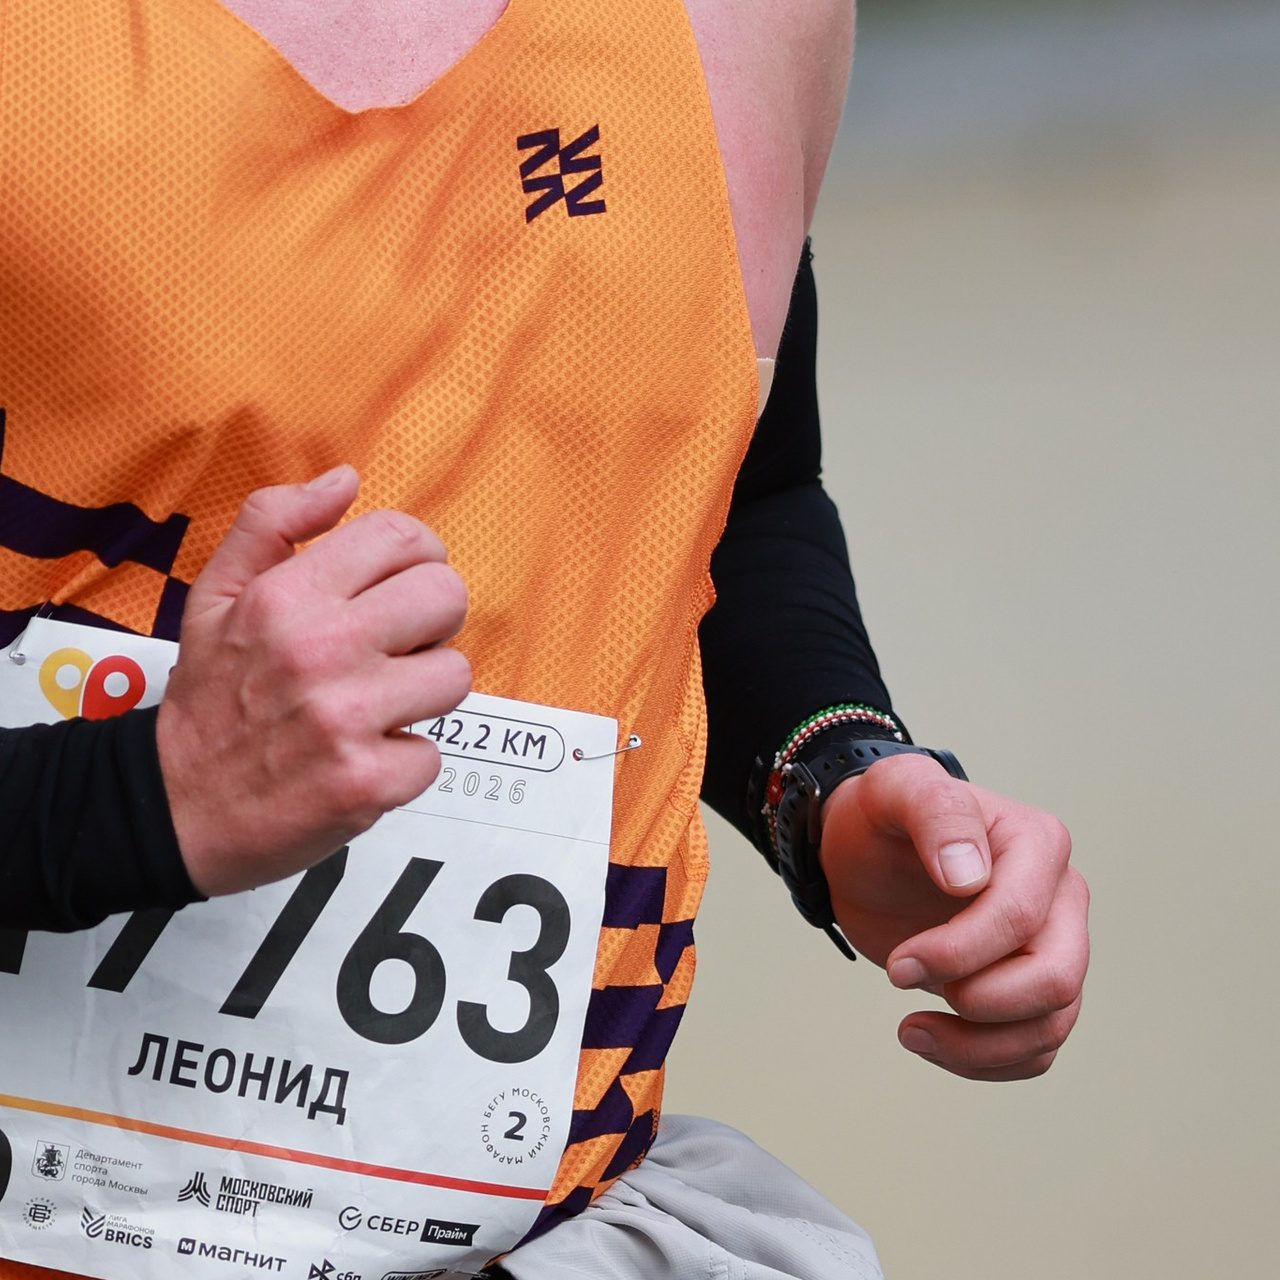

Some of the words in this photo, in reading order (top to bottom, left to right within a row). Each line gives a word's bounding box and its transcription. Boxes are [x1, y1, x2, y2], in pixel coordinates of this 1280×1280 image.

[428, 716, 491, 751] 42,2
[438, 766, 527, 804] 2026
[128, 1032, 350, 1125] ЛЕОНИД
[484, 1091, 505, 1119] БЕГУ
[503, 1110, 528, 1142] 2
[512, 1087, 551, 1159] МОСКОВСКИЙ
[481, 1124, 523, 1165] МАРАФОН
[73, 1162, 108, 1176] спорта
[75, 1149, 143, 1171] Департамент
[71, 1173, 106, 1188] города
[108, 1179, 149, 1196] Москвы
[219, 1176, 314, 1209] МОСКОВСКИЙ
[108, 1214, 128, 1224] ЛИГА
[215, 1194, 261, 1218] СПОРТ
[104, 1228, 154, 1250] BRICS
[106, 1221, 155, 1236] МАРАФОНОВ
[366, 1214, 420, 1236] СБЕР
[428, 1224, 468, 1241] Прайм
